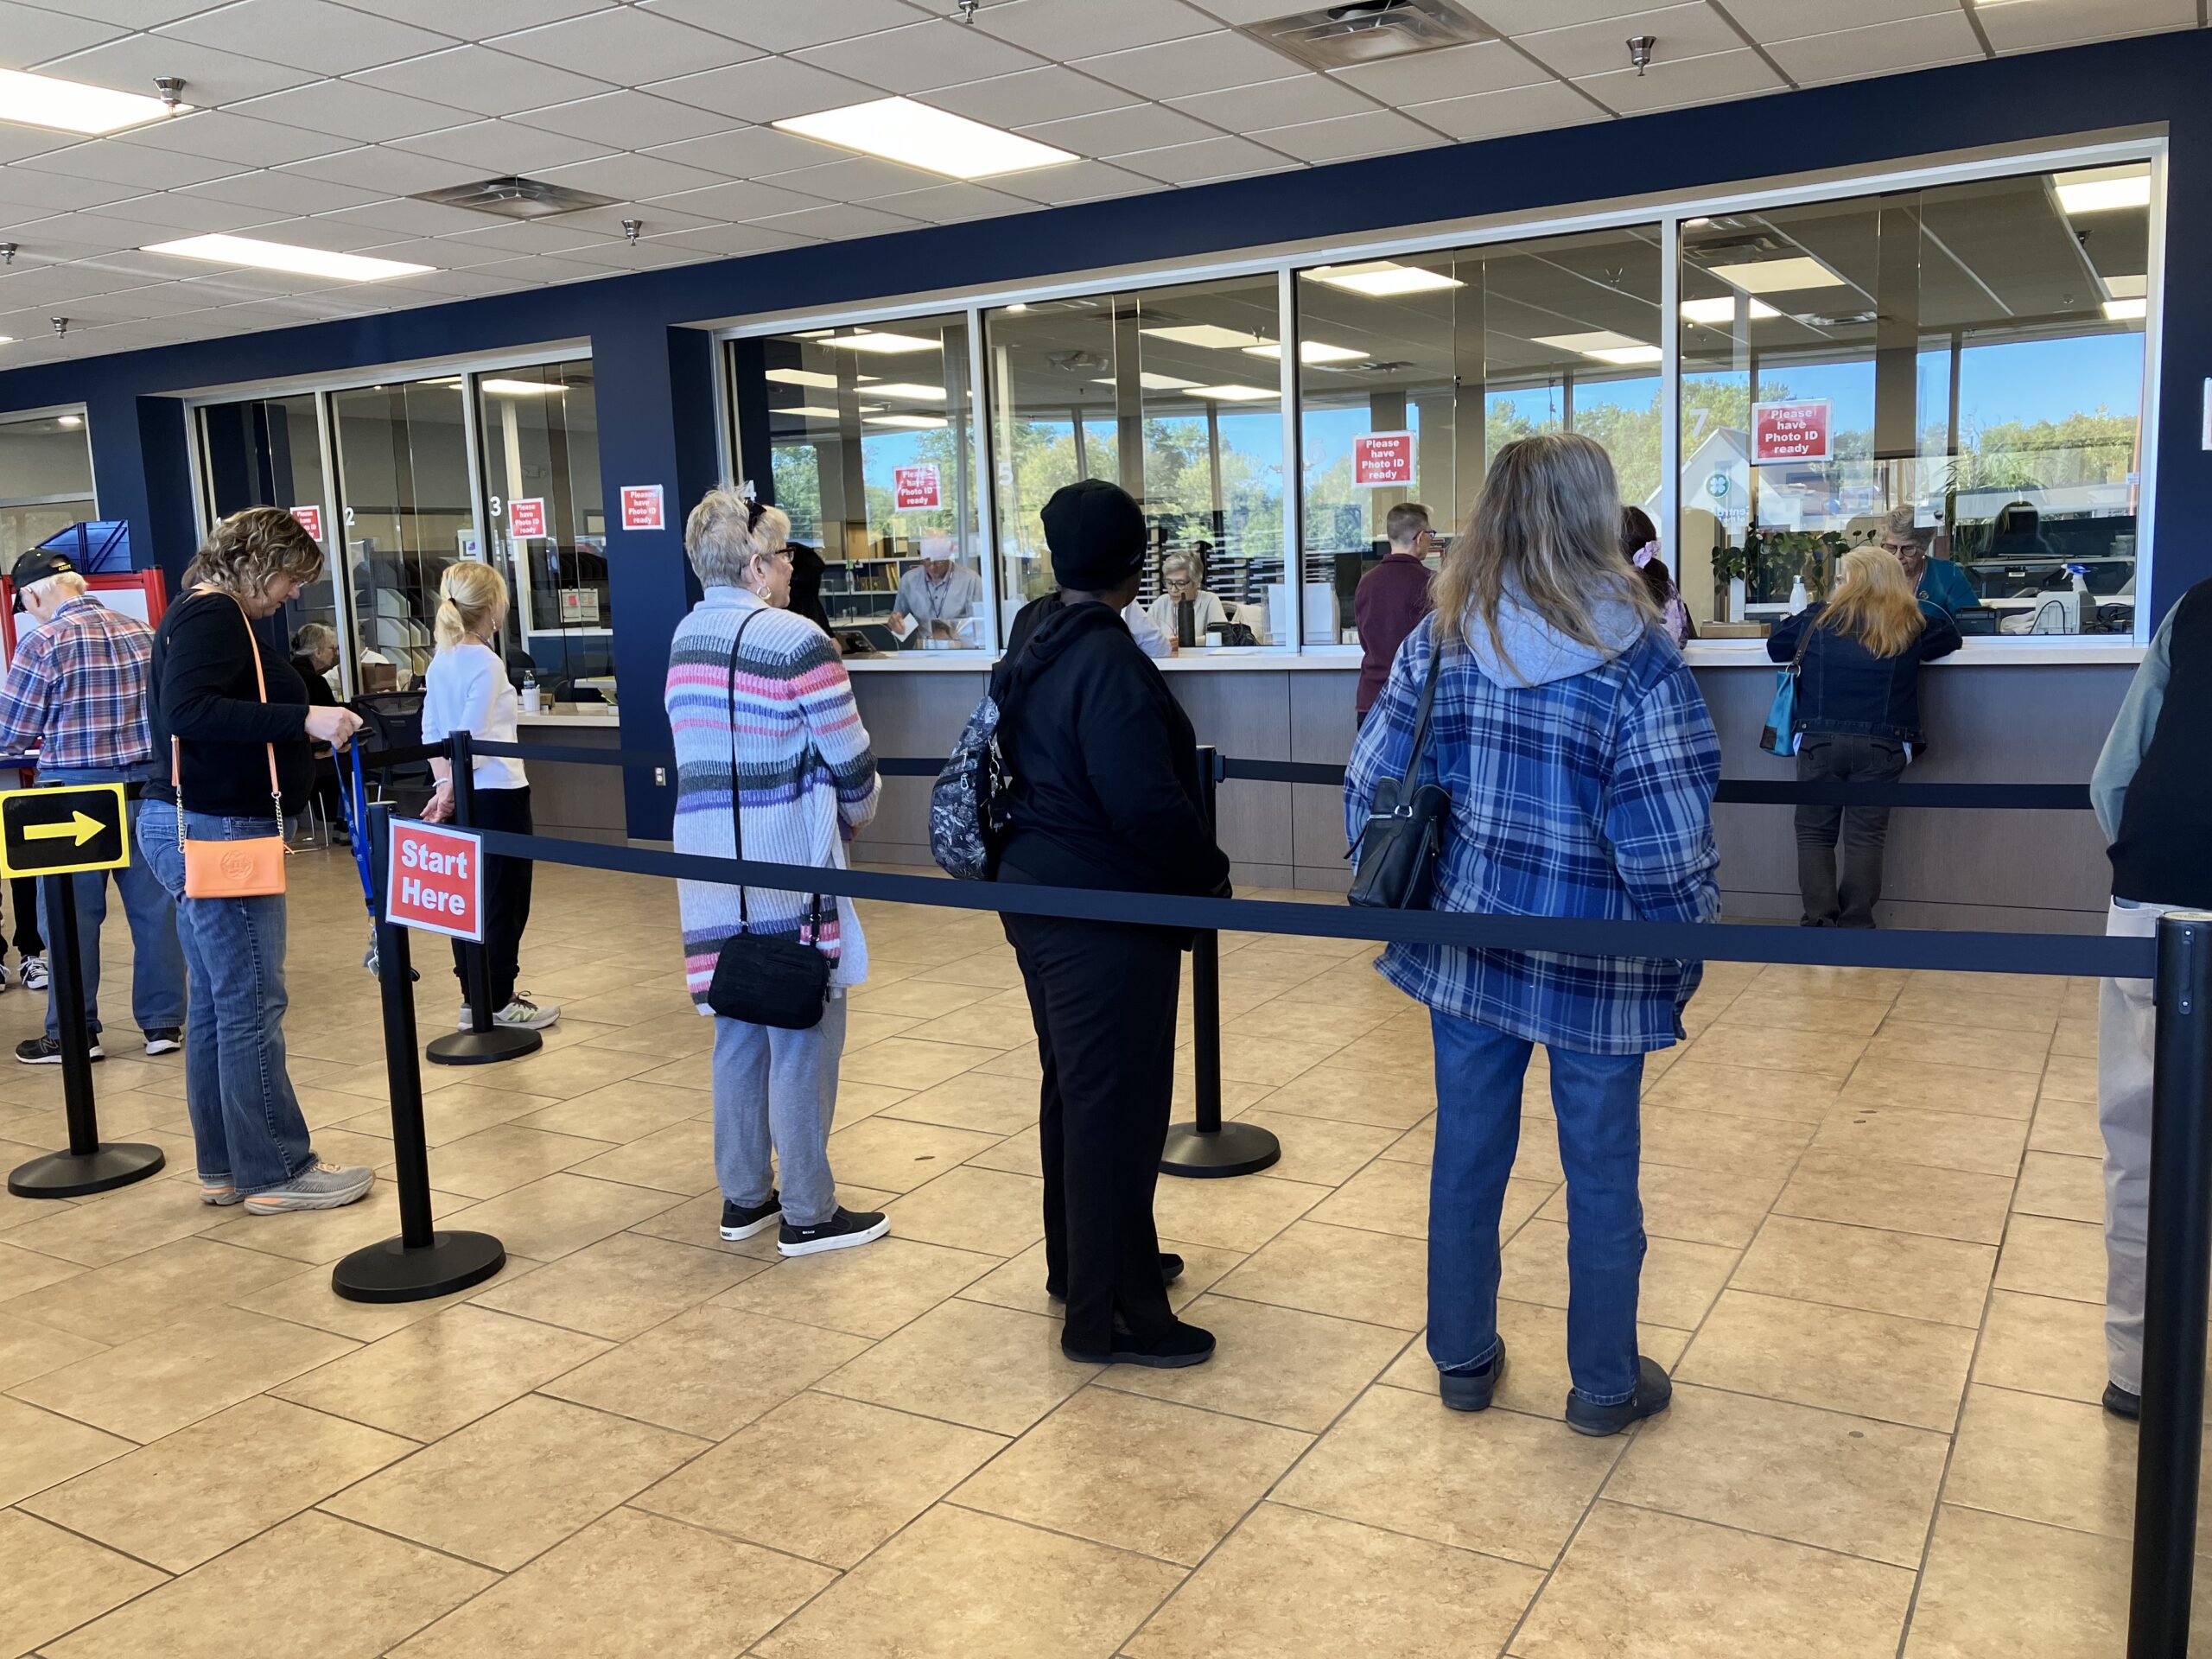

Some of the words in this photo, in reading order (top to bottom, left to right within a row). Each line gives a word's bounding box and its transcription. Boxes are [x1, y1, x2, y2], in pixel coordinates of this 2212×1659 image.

[1771, 409, 1812, 419] Please
[1689, 408, 1709, 437] 7
[1777, 420, 1807, 430] have
[1765, 432, 1801, 442] Photo
[1805, 431, 1818, 440] ID
[1366, 439, 1400, 448] Please
[1774, 444, 1809, 454] ready
[1308, 438, 1326, 464] 6
[1371, 449, 1395, 458] have
[1362, 460, 1391, 469] Photo
[1393, 459, 1404, 467] ID
[999, 462, 1014, 485] 5
[1369, 470, 1397, 480] ready
[744, 480, 756, 501] 4
[490, 496, 501, 516] 3
[907, 496, 928, 505] ready
[345, 507, 355, 526] 2
[401, 839, 468, 879] Start
[401, 876, 465, 915] Here
